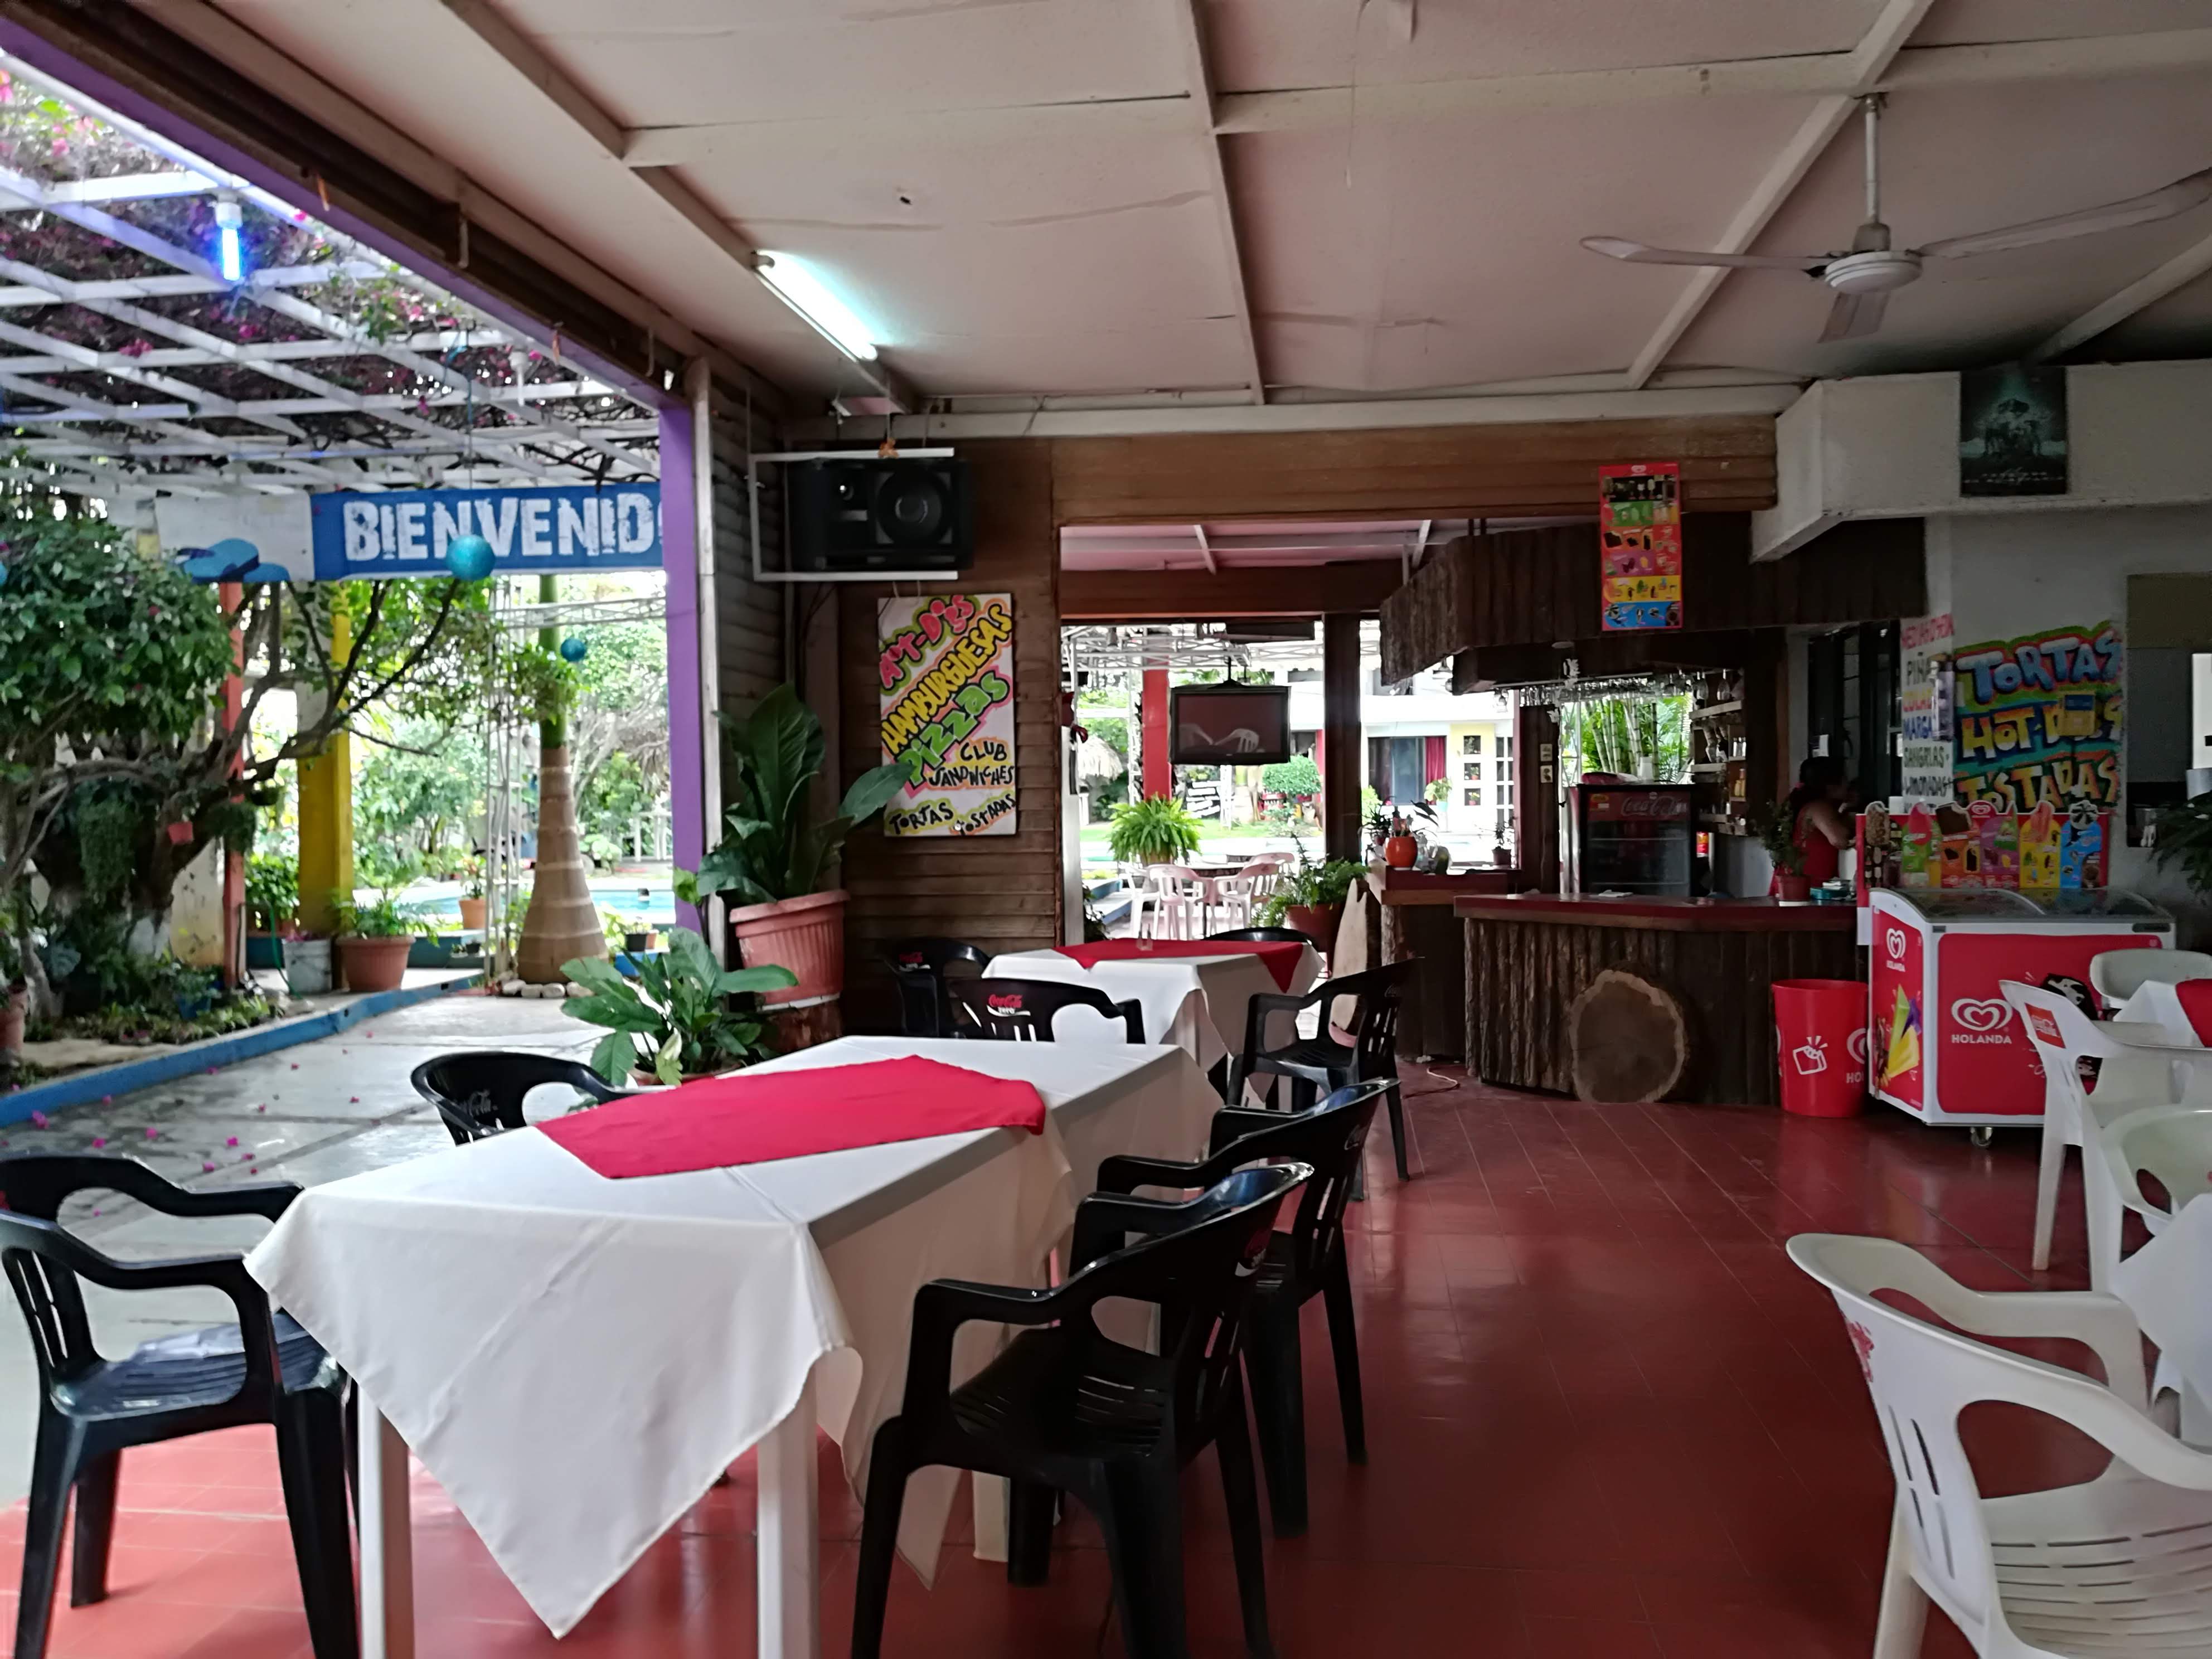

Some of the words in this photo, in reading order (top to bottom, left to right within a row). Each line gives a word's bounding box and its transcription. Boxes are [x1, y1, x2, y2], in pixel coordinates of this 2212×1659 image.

[343, 492, 662, 561] BIENVENID
[881, 604, 1012, 755] HAMBURGUESAS
[959, 741, 1008, 762] CLUB
[929, 765, 1015, 788] SANDWICHES
[889, 801, 954, 835] TORTAS
[1951, 1035, 2012, 1044] HOLANDA
